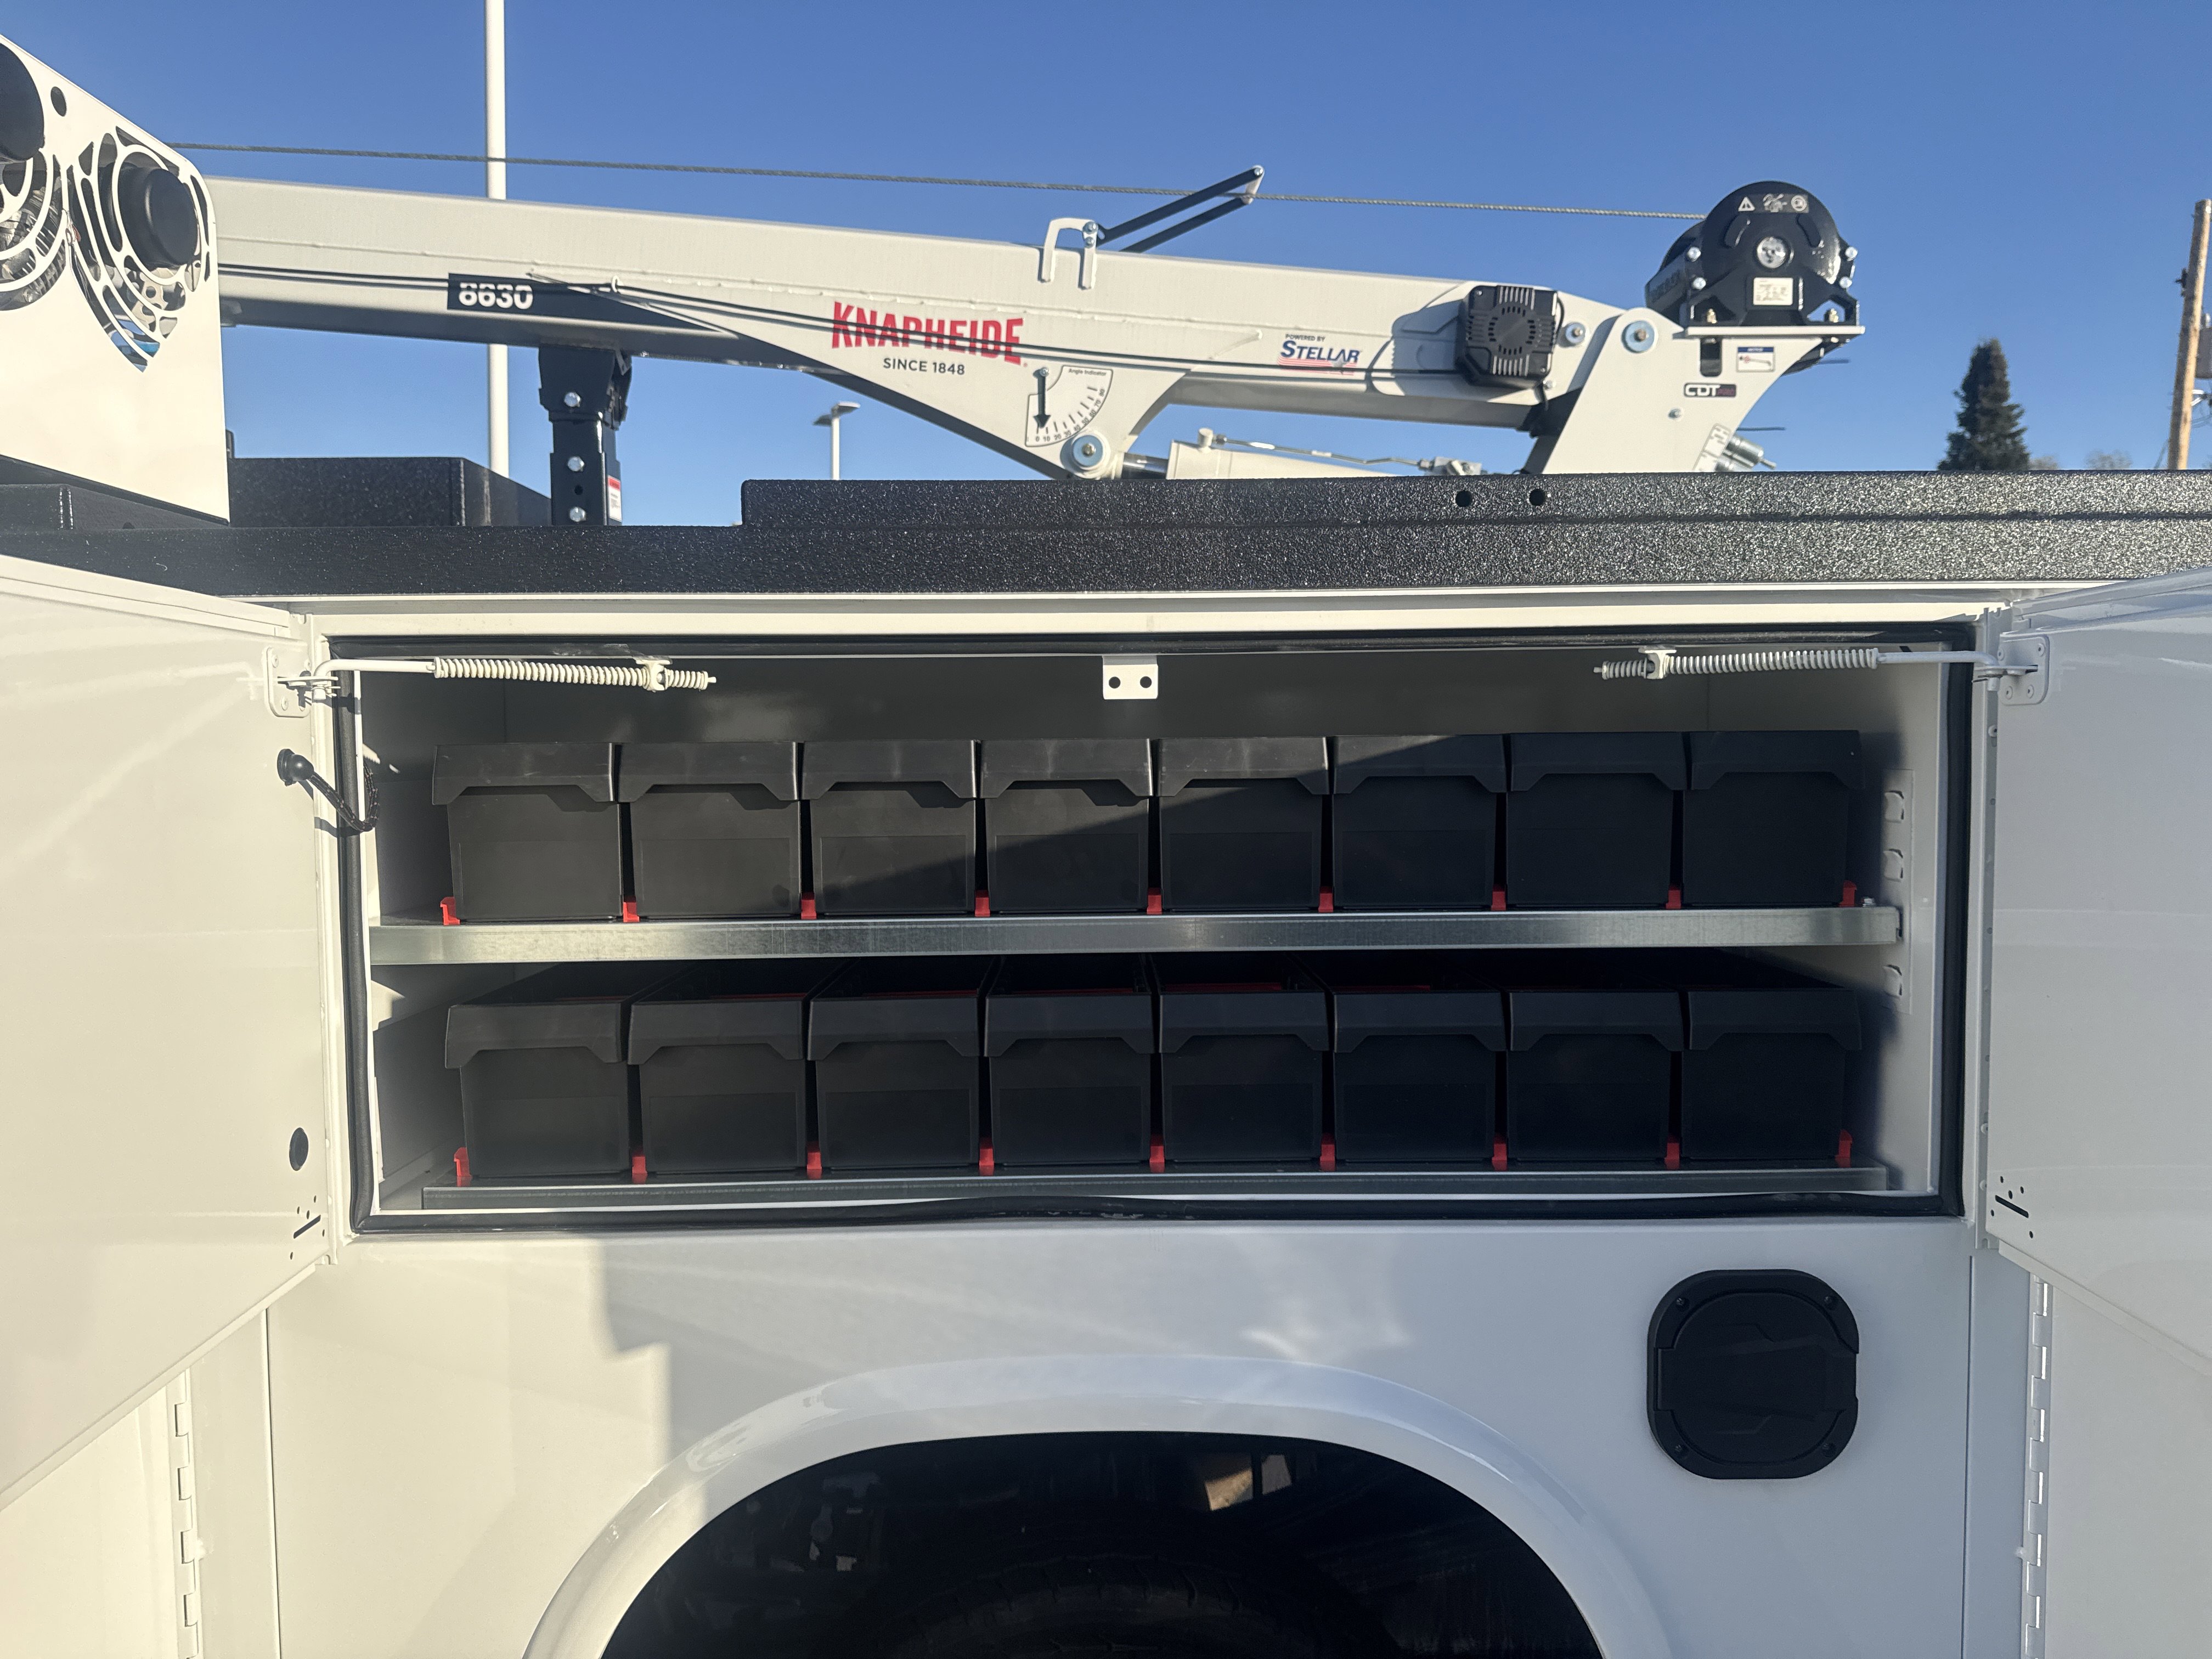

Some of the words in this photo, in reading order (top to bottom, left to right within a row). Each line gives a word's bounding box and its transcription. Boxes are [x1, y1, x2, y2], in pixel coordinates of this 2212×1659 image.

[459, 282, 533, 309] 8630
[832, 302, 1024, 366] KNAPHEIDE
[1281, 340, 1360, 363] STELLAR
[883, 358, 927, 372] SINCE
[932, 362, 965, 375] 1848
[1685, 385, 1721, 396] CDT
[1082, 417, 1090, 425] 50
